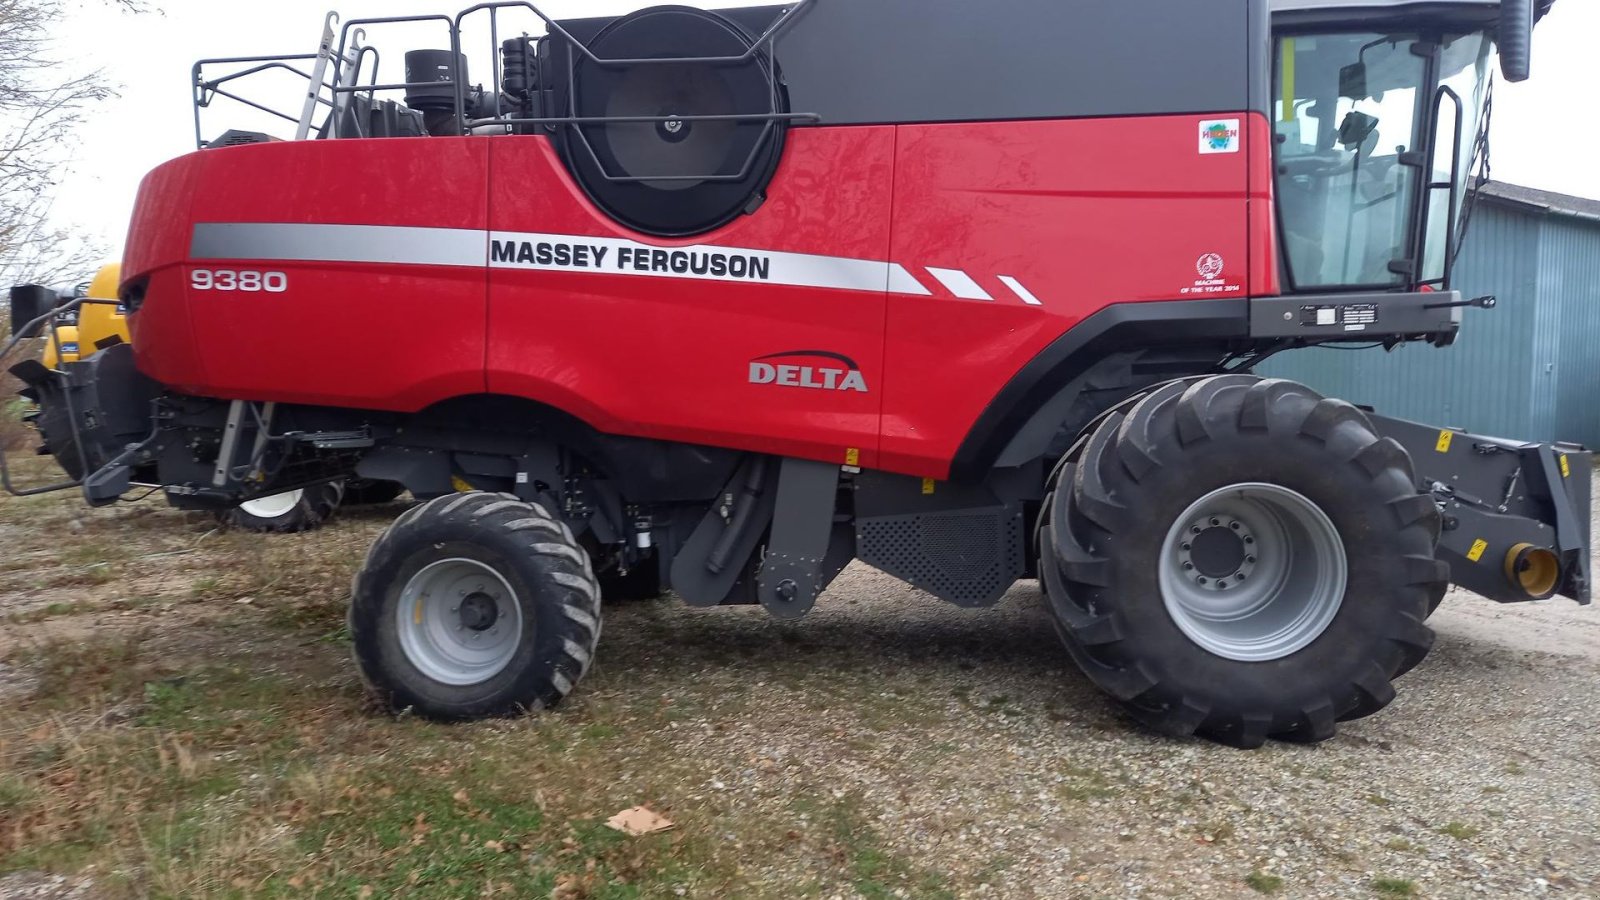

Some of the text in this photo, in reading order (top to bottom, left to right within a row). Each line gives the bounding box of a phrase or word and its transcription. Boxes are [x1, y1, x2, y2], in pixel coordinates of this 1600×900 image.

[491, 240, 770, 279] MASSEY FERGUSON
[191, 269, 288, 293] 9380
[748, 361, 868, 392] DELTA
